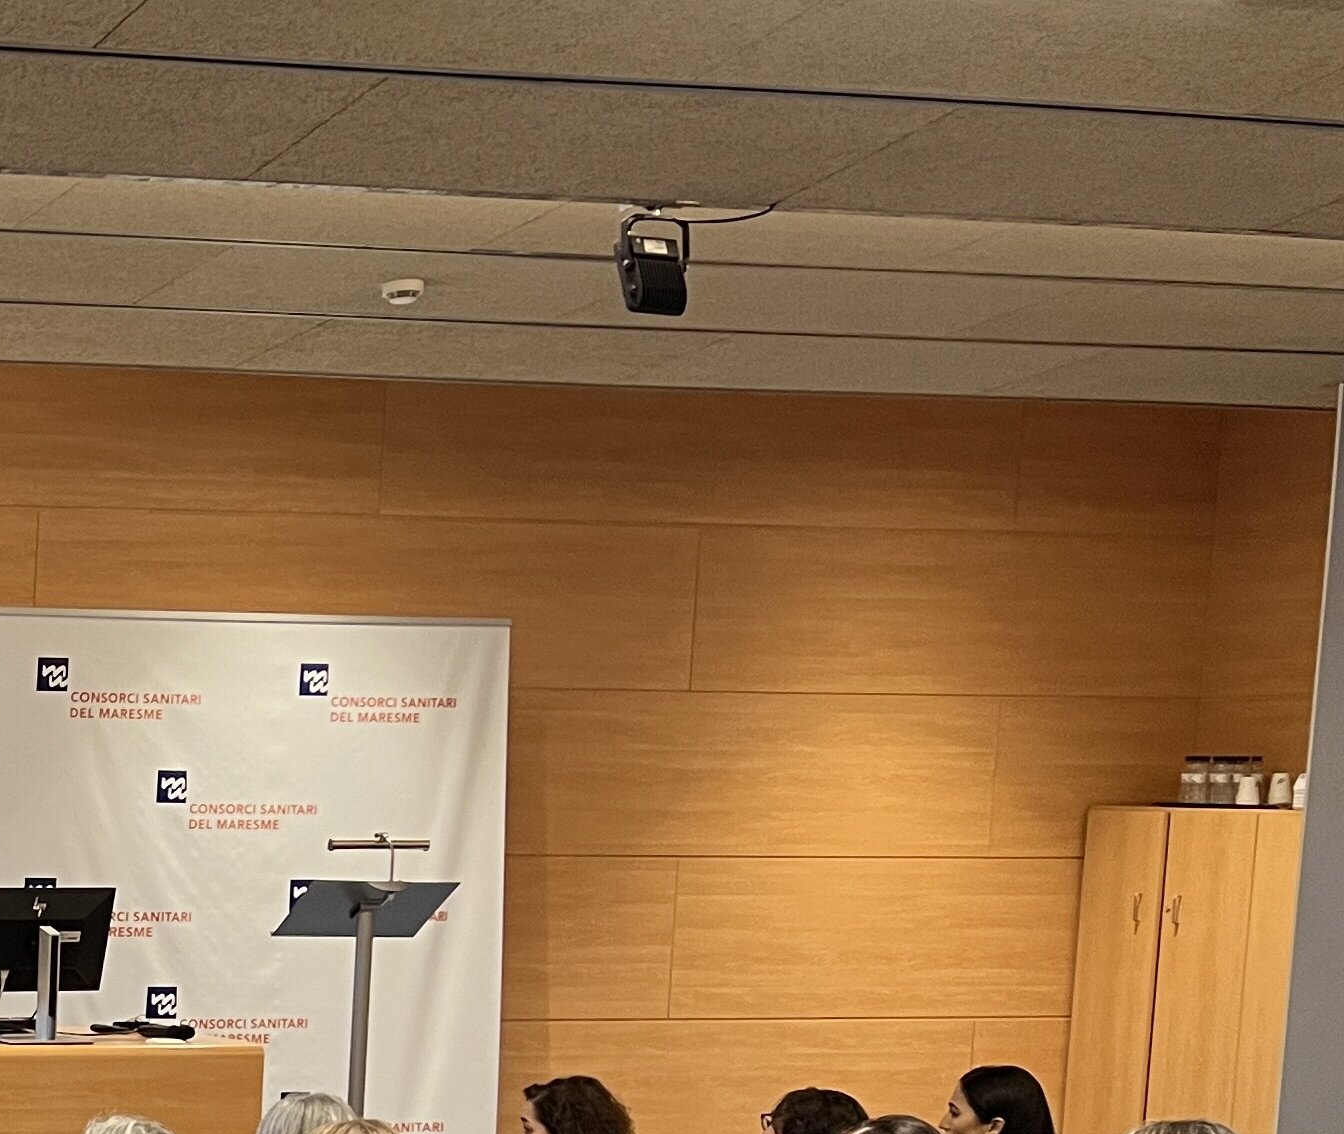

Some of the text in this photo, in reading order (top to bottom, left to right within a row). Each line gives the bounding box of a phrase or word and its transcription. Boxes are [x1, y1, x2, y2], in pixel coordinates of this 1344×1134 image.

[70, 691, 202, 705] CONSORCI SANITARI
[331, 696, 458, 708] CONSORCI SANITARI
[70, 707, 163, 720] DEL MARESME
[330, 712, 421, 723] DEL MARESME
[189, 803, 318, 815] CONSORCI SANITARI
[188, 819, 280, 830] DEL MARESME
[133, 911, 192, 922] SANITARI
[109, 926, 153, 937] RESME
[180, 1018, 309, 1030] CONSORCI SANITARI
[207, 1033, 270, 1044] ESME
[388, 1122, 444, 1133] ANITARI
